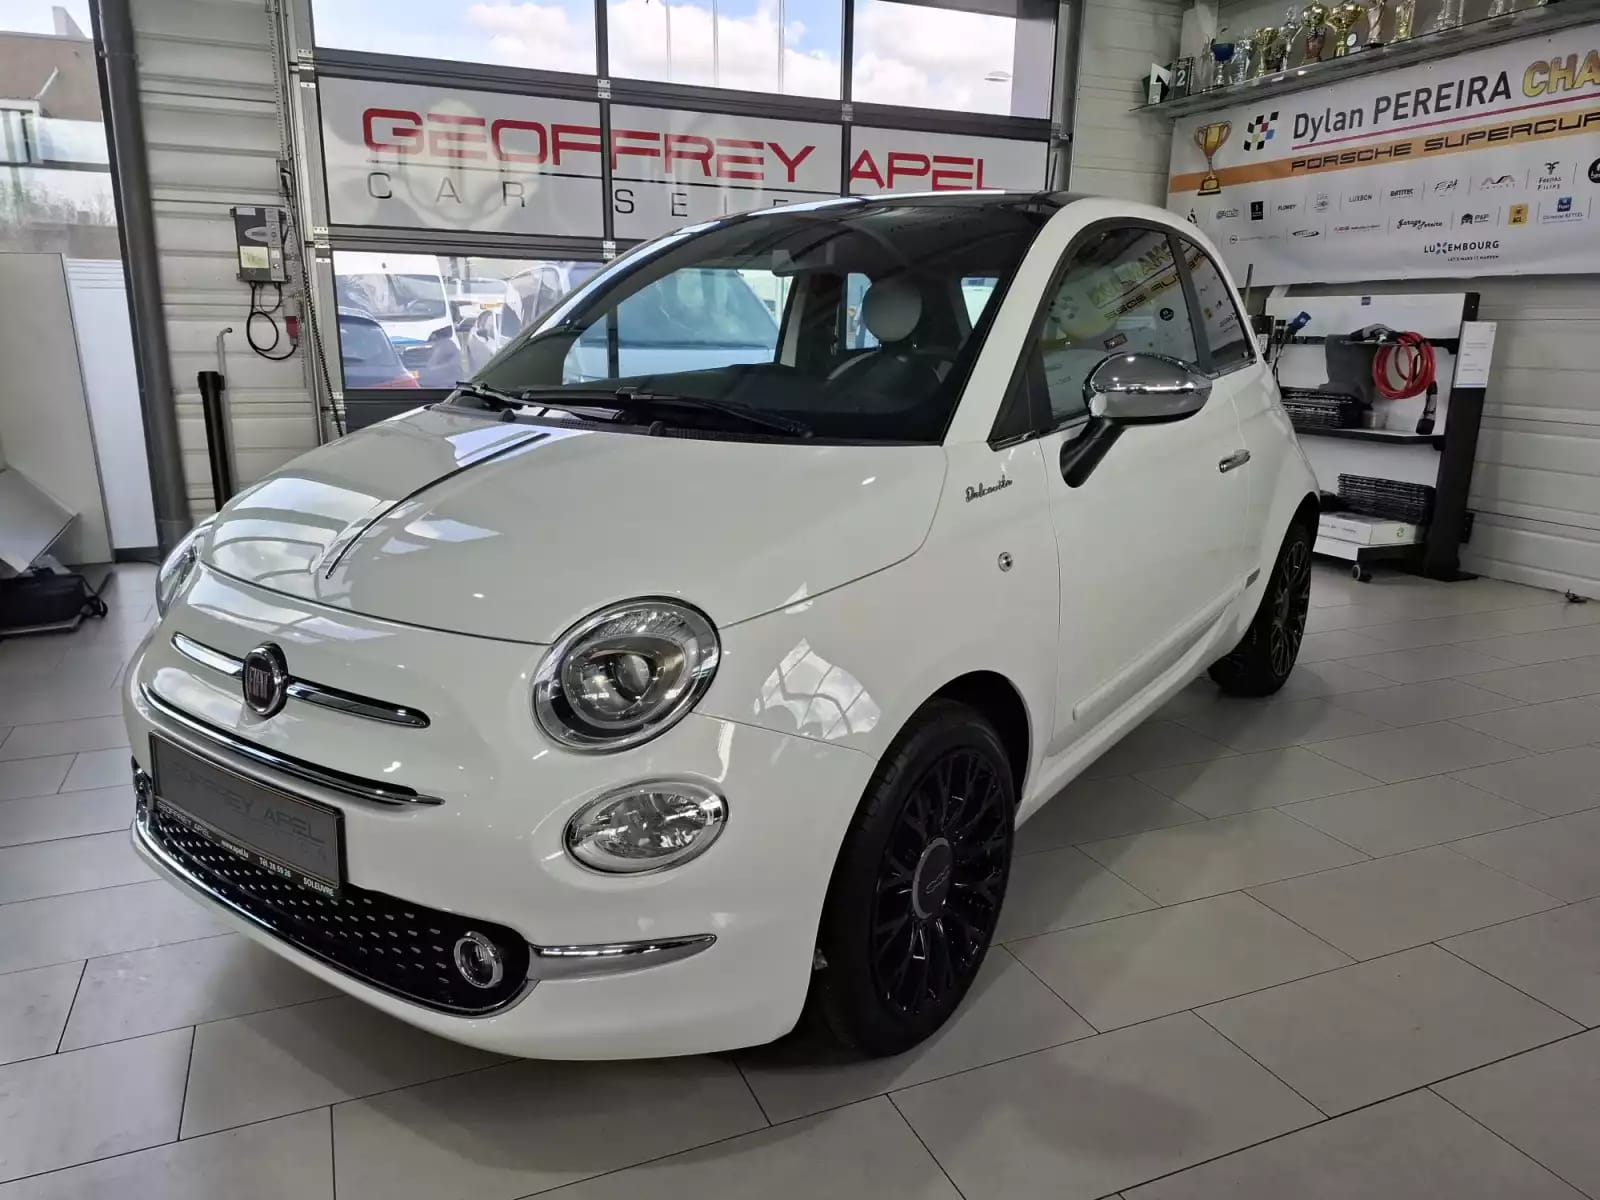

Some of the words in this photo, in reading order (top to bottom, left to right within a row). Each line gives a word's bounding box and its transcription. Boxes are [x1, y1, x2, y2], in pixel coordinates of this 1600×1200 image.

[1293, 107, 1364, 142] Dylan
[1373, 71, 1512, 125] PEREIRA
[362, 108, 816, 182] GEOFFREY
[850, 149, 1004, 191] APEL
[1291, 143, 1412, 171] PORSCHE
[367, 172, 526, 208] CAR
[1424, 240, 1500, 255] LUXEMBOURG
